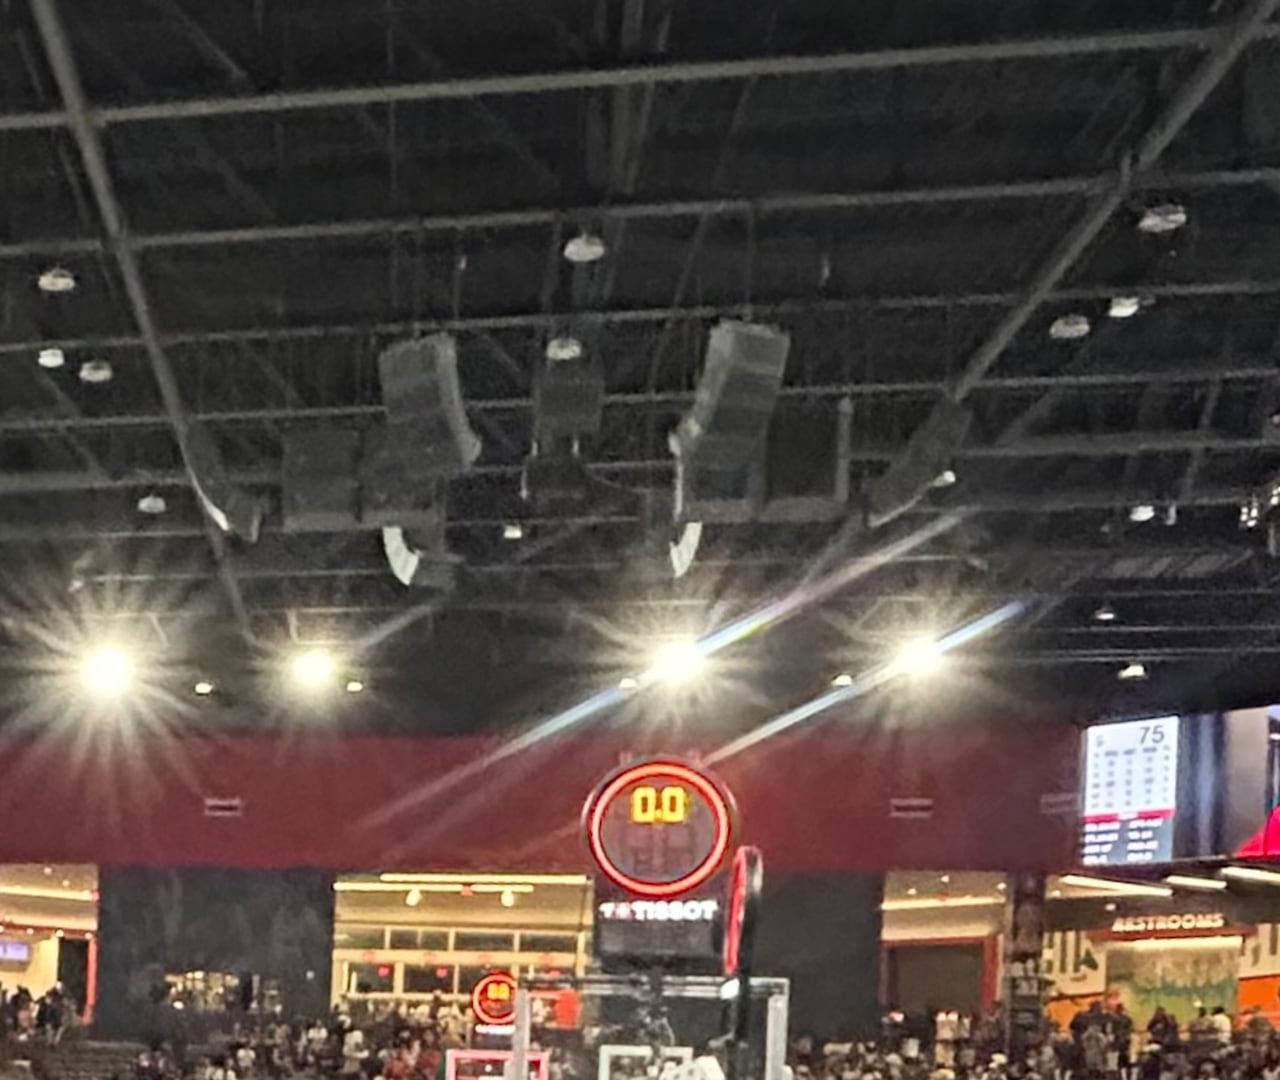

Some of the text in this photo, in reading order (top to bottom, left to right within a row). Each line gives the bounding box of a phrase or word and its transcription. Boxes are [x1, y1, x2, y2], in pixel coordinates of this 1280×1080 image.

[1139, 725, 1164, 744] 75
[633, 786, 686, 823] 0.0
[631, 900, 719, 921] TISSOT
[1111, 912, 1225, 932] RESTROOMS
